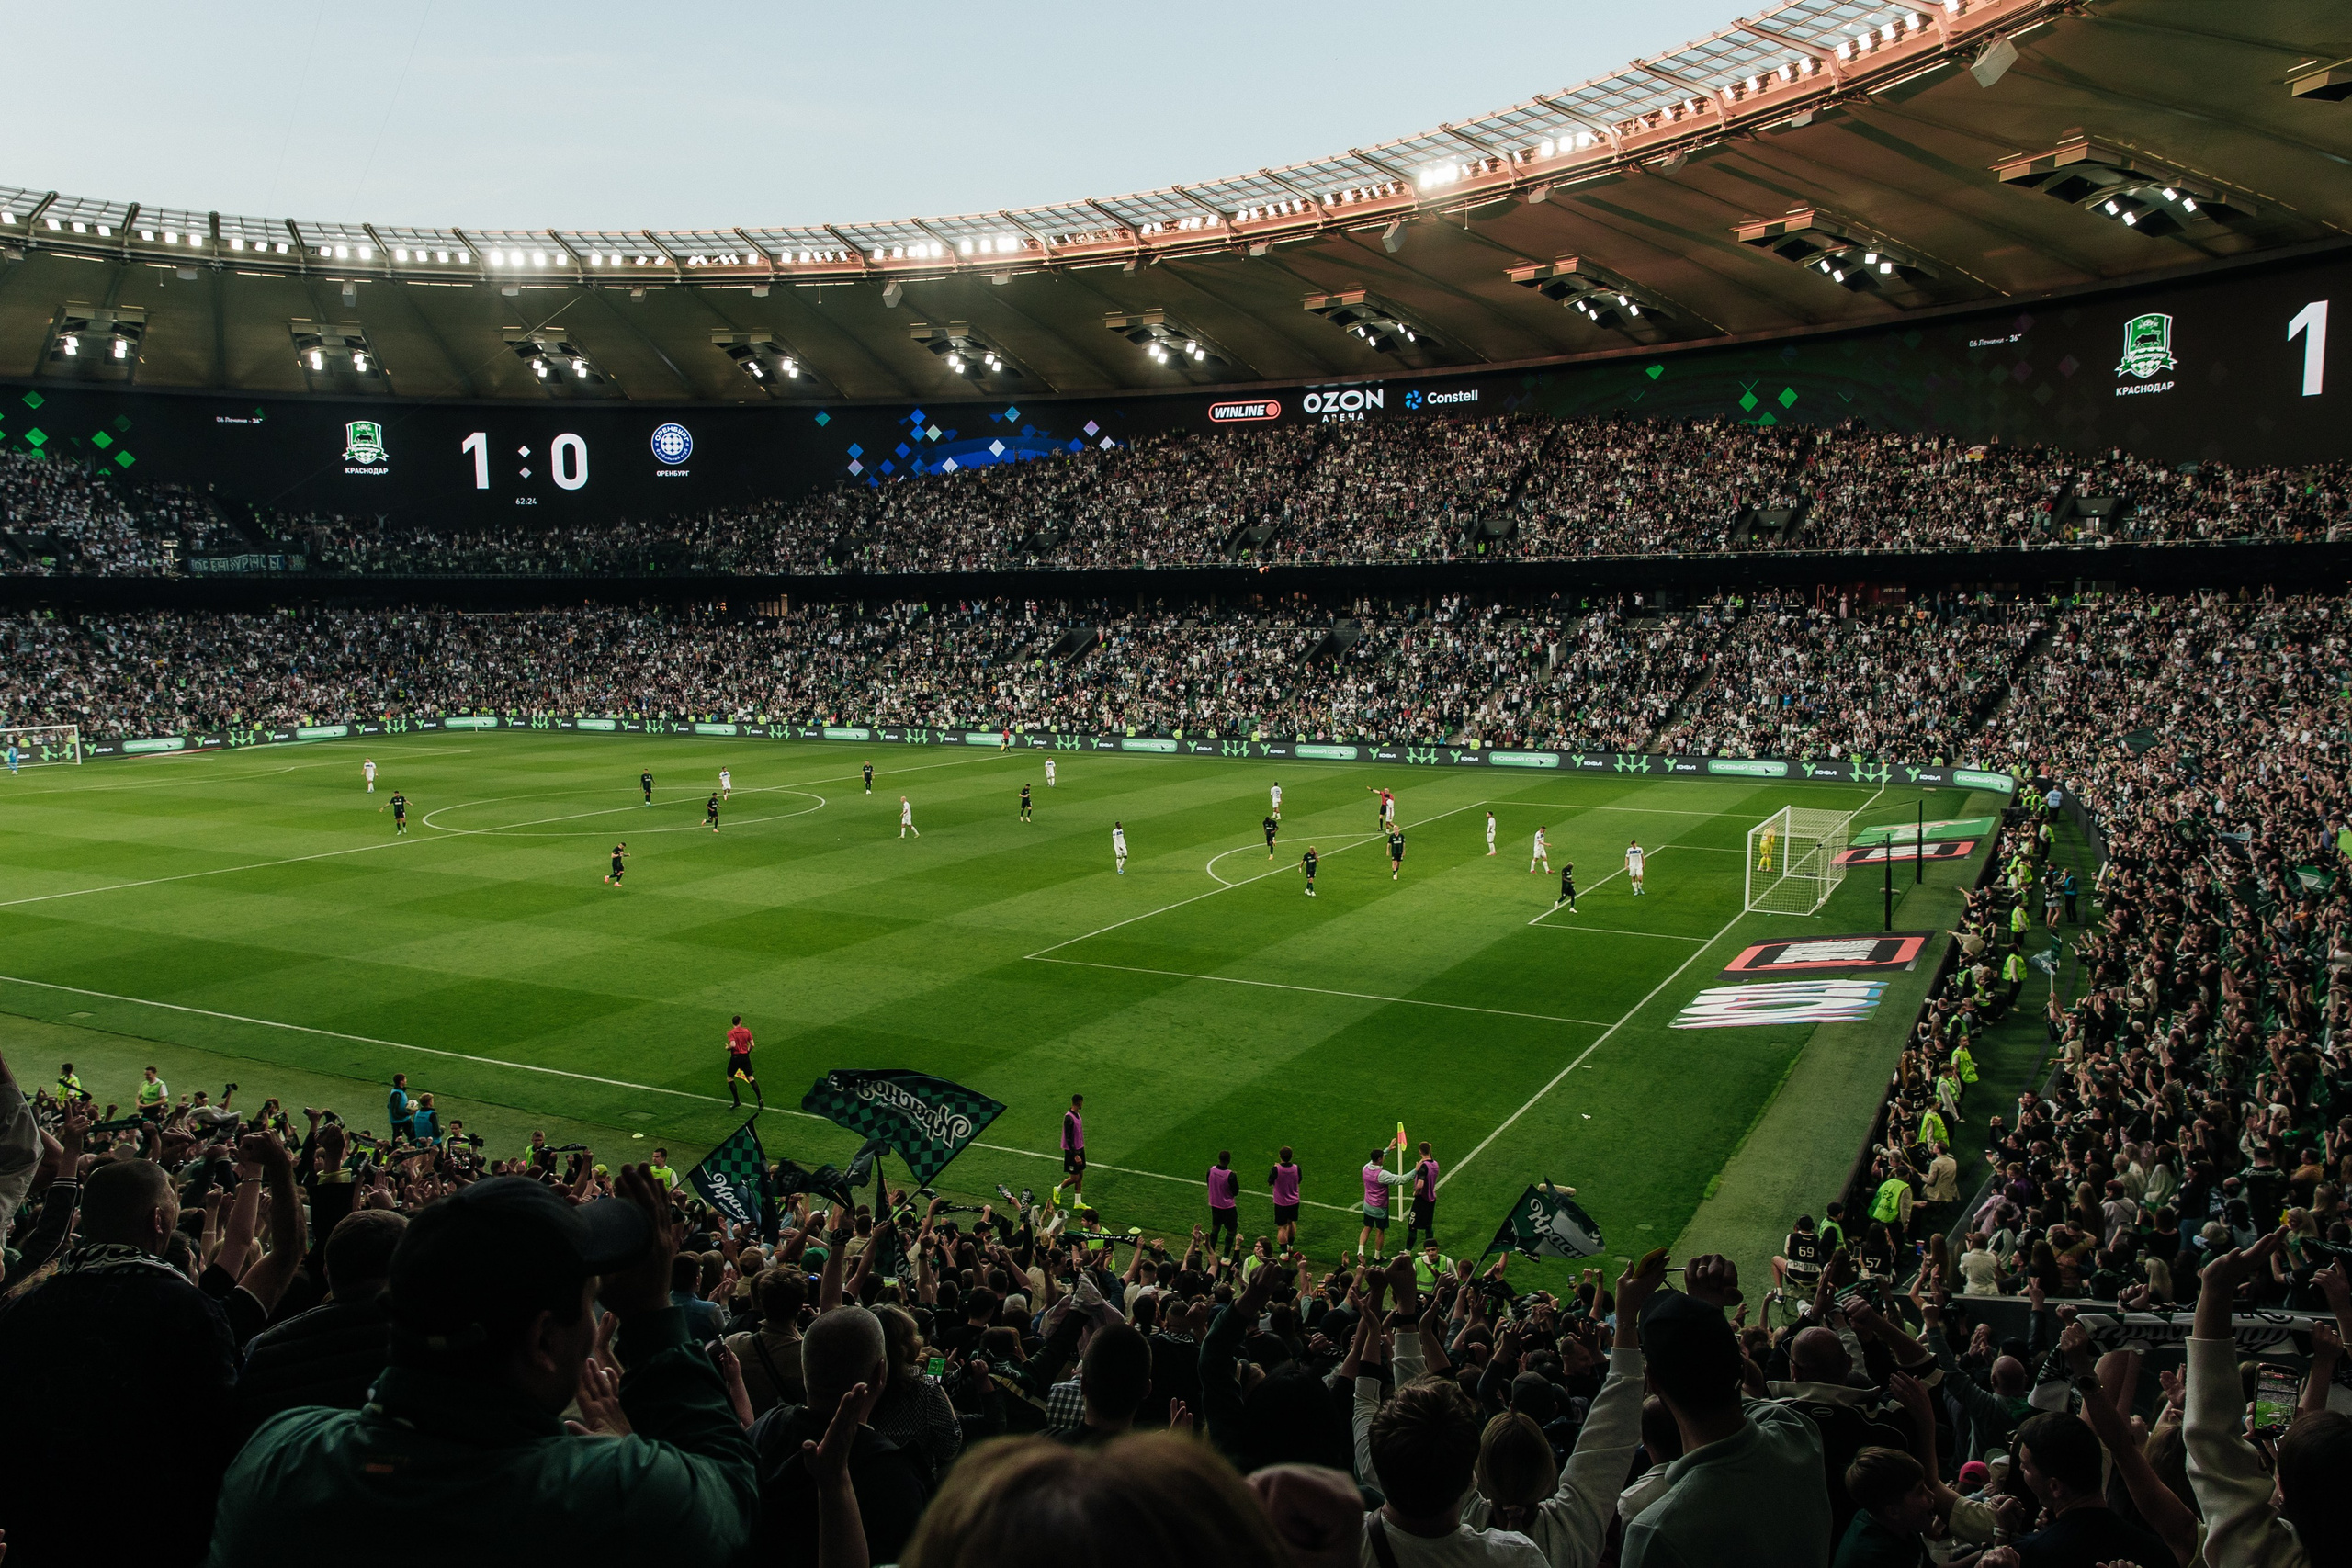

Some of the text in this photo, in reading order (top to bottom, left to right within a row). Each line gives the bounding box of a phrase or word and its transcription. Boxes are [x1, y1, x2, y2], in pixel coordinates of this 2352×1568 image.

[2288, 299, 2329, 397] 1
[2115, 380, 2175, 396] КРАСНОДАР
[1303, 389, 1385, 414] OZON
[1427, 389, 1478, 405] Constell
[1214, 404, 1266, 419] WINLINE
[655, 425, 690, 443] ОРЕНБУРГ
[461, 432, 490, 490] 1
[550, 433, 589, 491] 0
[345, 467, 389, 476] КРАСНОДАР
[515, 497, 537, 505] 62:24
[1798, 1246, 1815, 1258] 69
[1865, 1257, 1882, 1269] 57
